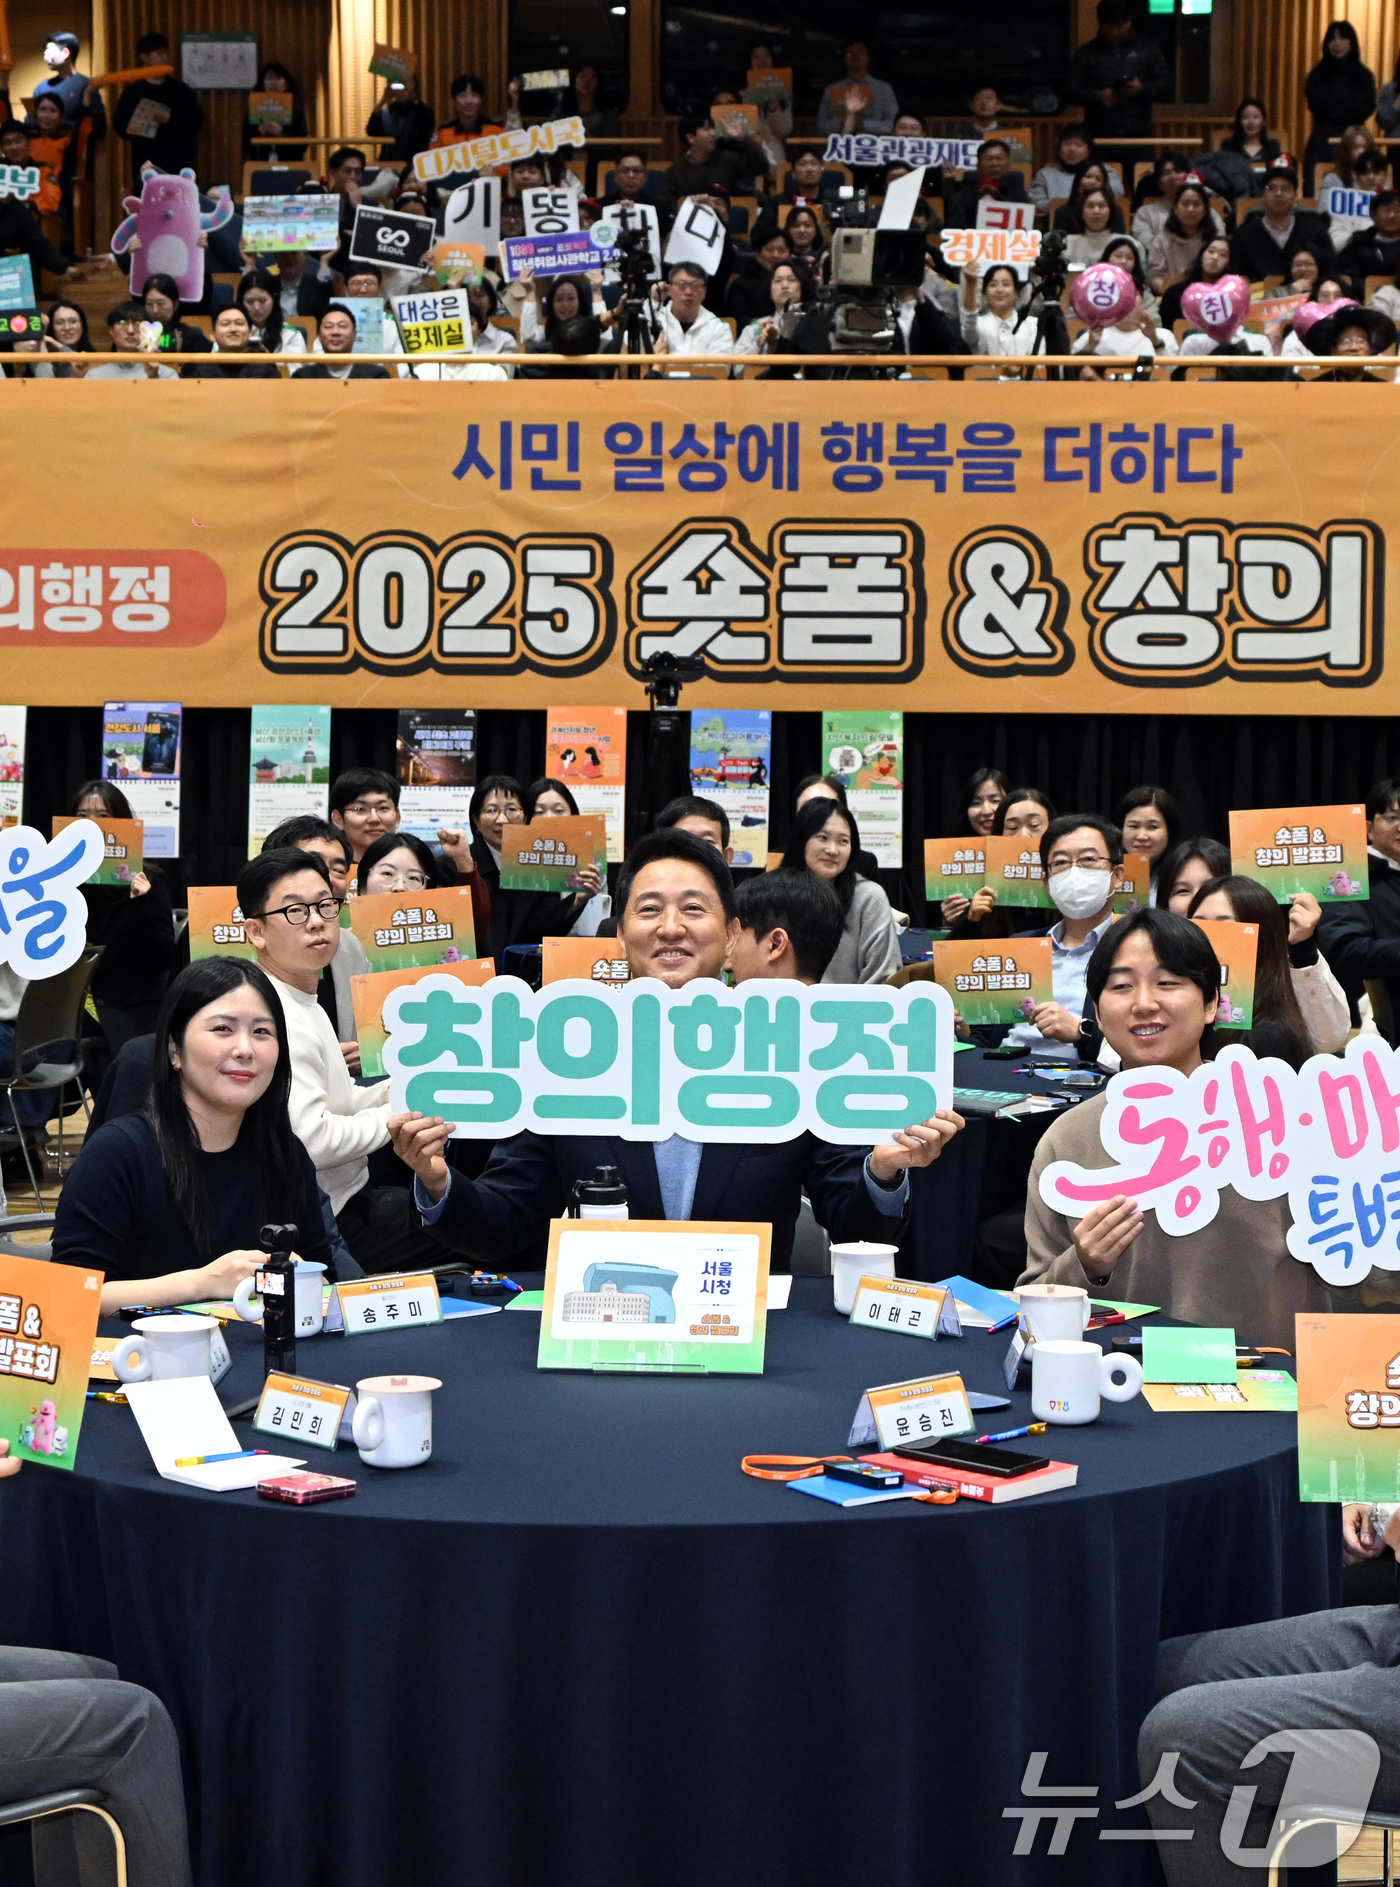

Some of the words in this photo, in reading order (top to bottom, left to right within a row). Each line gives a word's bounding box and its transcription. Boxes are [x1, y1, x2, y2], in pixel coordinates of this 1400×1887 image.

[415, 119, 583, 179] 디지털도시국
[452, 182, 491, 228] 기
[531, 193, 571, 234] 똥
[684, 205, 721, 249] 다
[377, 244, 405, 256] SEOUL
[509, 243, 536, 257] 1089
[944, 231, 1040, 263] 경제실
[1093, 278, 1116, 308] 청
[398, 296, 461, 323] 대상은
[1204, 293, 1230, 322] 취
[452, 420, 582, 492] 시민
[603, 420, 800, 493] 일상에
[819, 421, 1022, 494] 행복을
[1042, 422, 1244, 494] 더하다
[265, 536, 609, 669] 2025
[630, 522, 915, 674] 숏폼
[949, 533, 1066, 667] &
[1090, 519, 1376, 677] 창의
[1275, 826, 1309, 846] 숏폼
[1312, 827, 1327, 844] &
[542, 852, 578, 866] 발표회
[1255, 846, 1290, 867] 창의
[1291, 844, 1343, 866] 발표회
[1003, 864, 1028, 880] 창의
[0, 838, 87, 961] 울
[391, 907, 424, 927] 숏폼
[425, 909, 438, 924] &
[374, 927, 406, 947] 창의
[407, 922, 454, 944] 발표회
[591, 957, 632, 981] 숏폼
[972, 955, 1003, 973] 숏폼
[1004, 957, 1018, 972] &
[955, 973, 986, 991] 창의
[986, 971, 1031, 992] 발표회
[398, 989, 938, 1129] 창의행정
[701, 1261, 733, 1277] 서울
[699, 1279, 732, 1295] 시청
[23, 1303, 42, 1339] &
